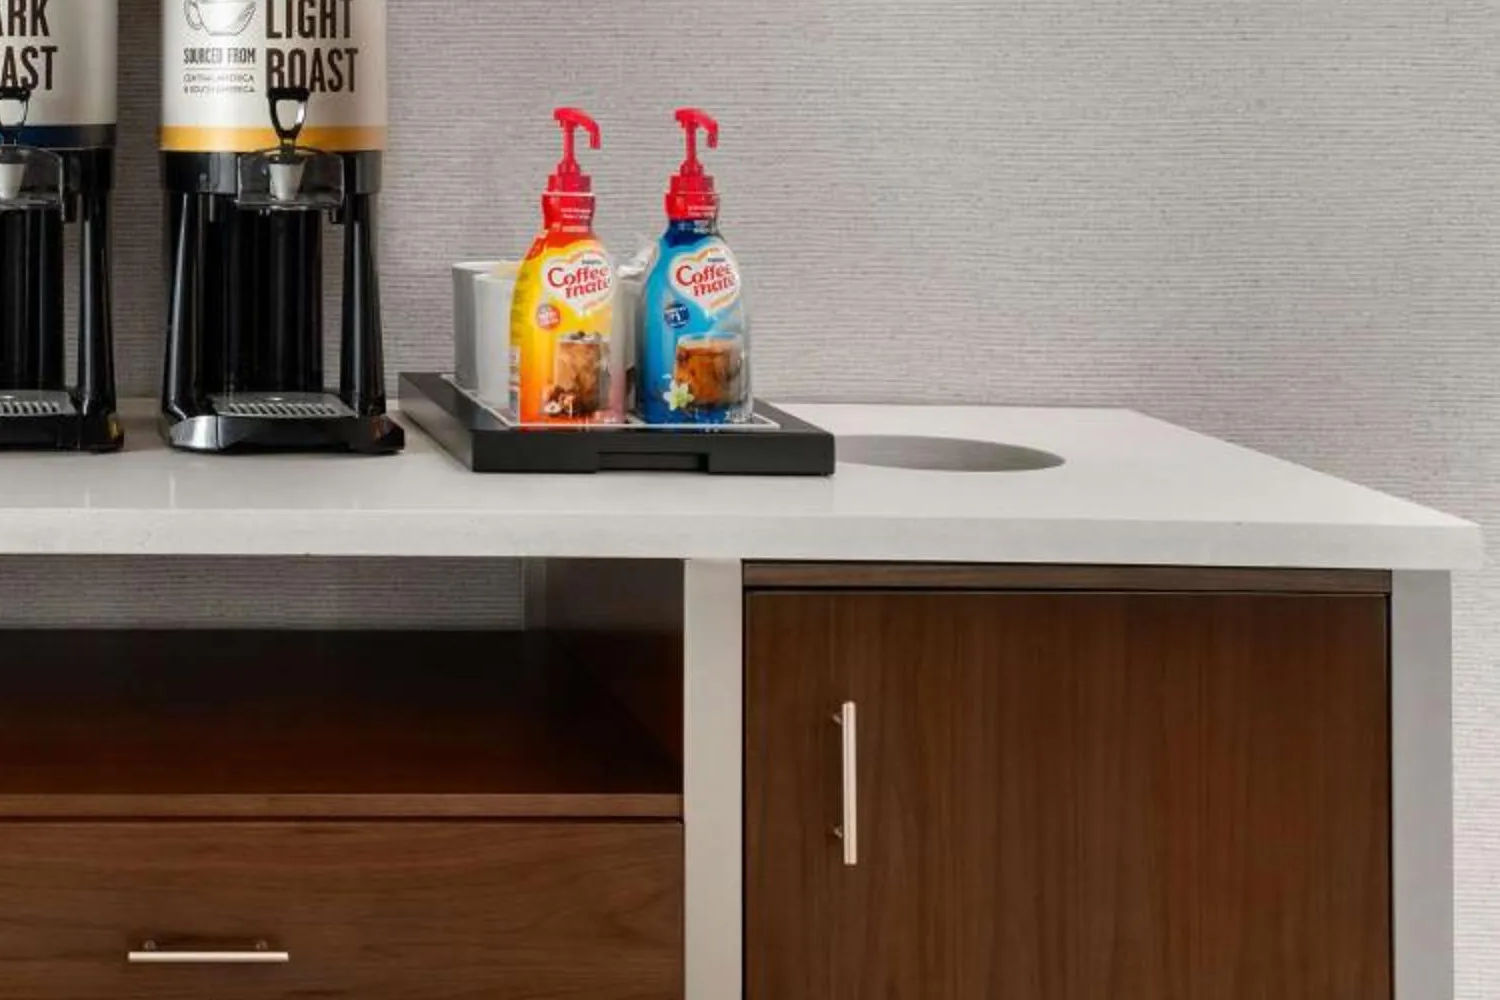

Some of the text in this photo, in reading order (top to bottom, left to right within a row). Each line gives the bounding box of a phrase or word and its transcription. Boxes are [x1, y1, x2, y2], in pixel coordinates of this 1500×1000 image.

[183, 47, 257, 65] SOURCED FROM
[265, 47, 360, 93] ROAST
[547, 266, 609, 288] Coffee
[675, 264, 731, 286] Coffee
